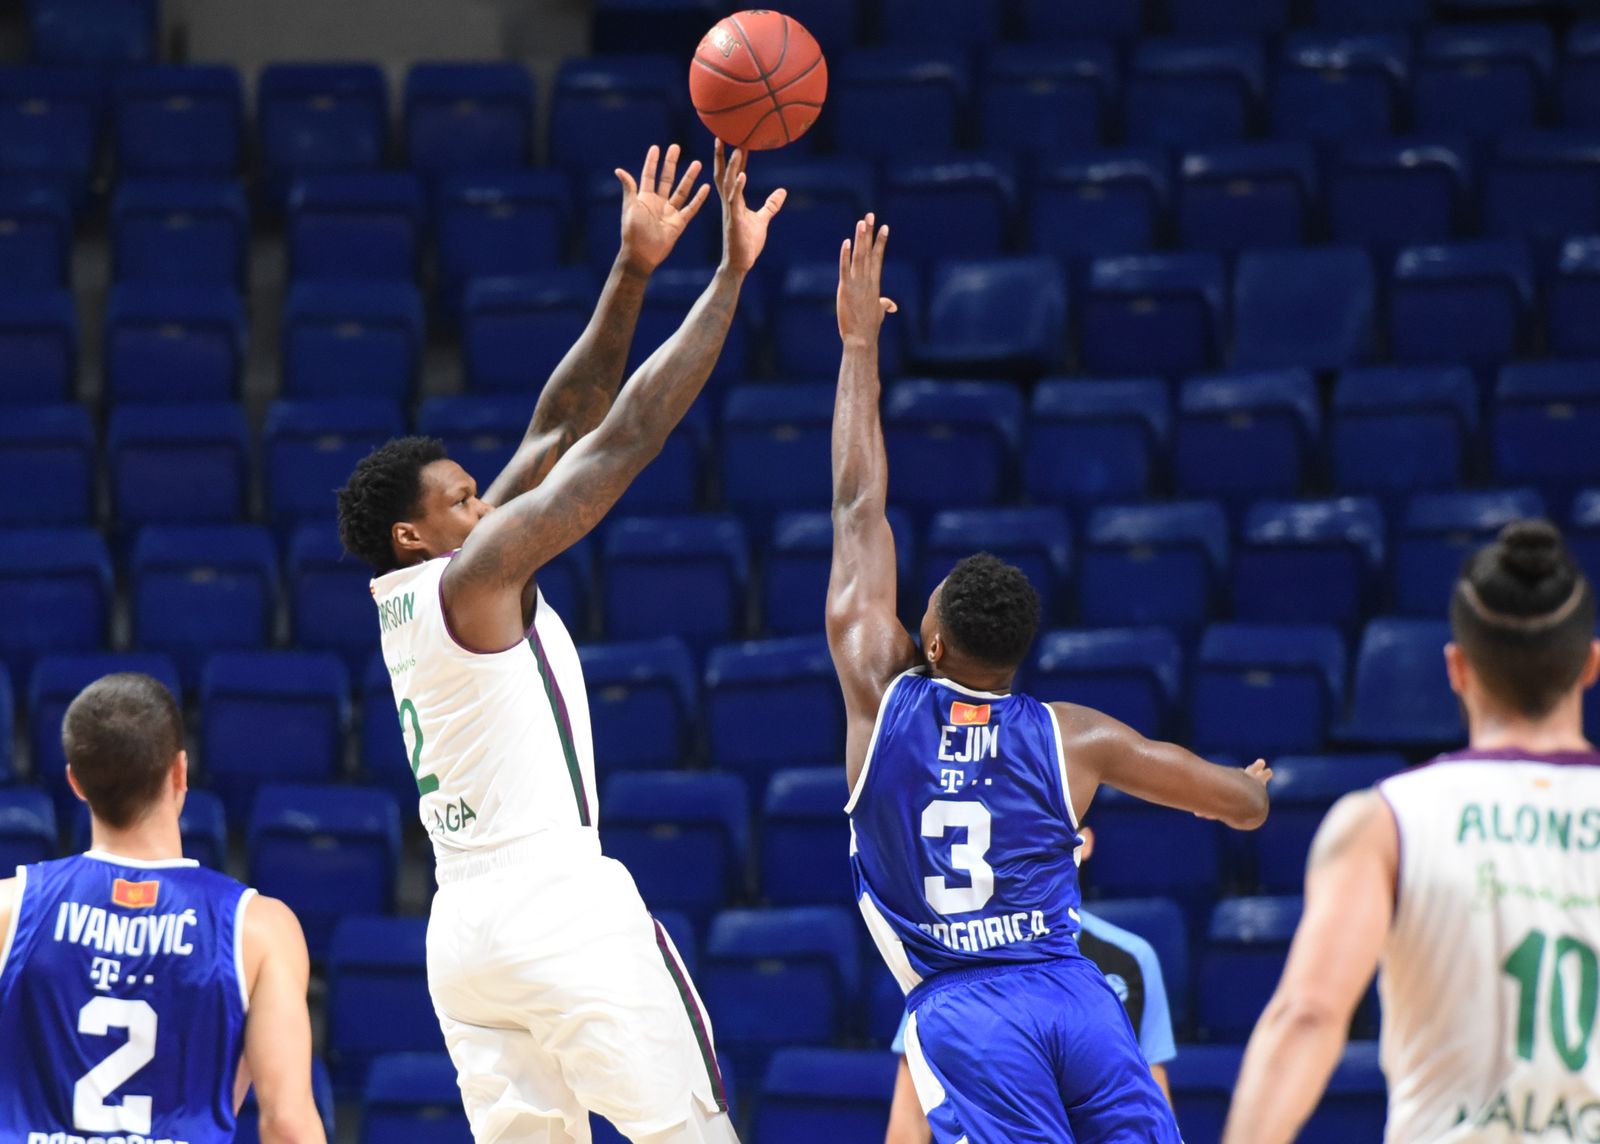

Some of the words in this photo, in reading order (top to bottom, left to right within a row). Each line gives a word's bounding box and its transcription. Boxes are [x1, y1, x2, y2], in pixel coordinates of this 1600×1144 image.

[399, 698, 439, 797] 2
[938, 725, 999, 762] EJIM
[430, 796, 477, 835] AGA
[1456, 802, 1600, 853] ALONS
[921, 800, 994, 915] 3
[54, 902, 197, 956] IVANOVIĆ
[913, 910, 1051, 952] DGORICA
[1502, 928, 1600, 1072] 10
[73, 995, 158, 1135] 2
